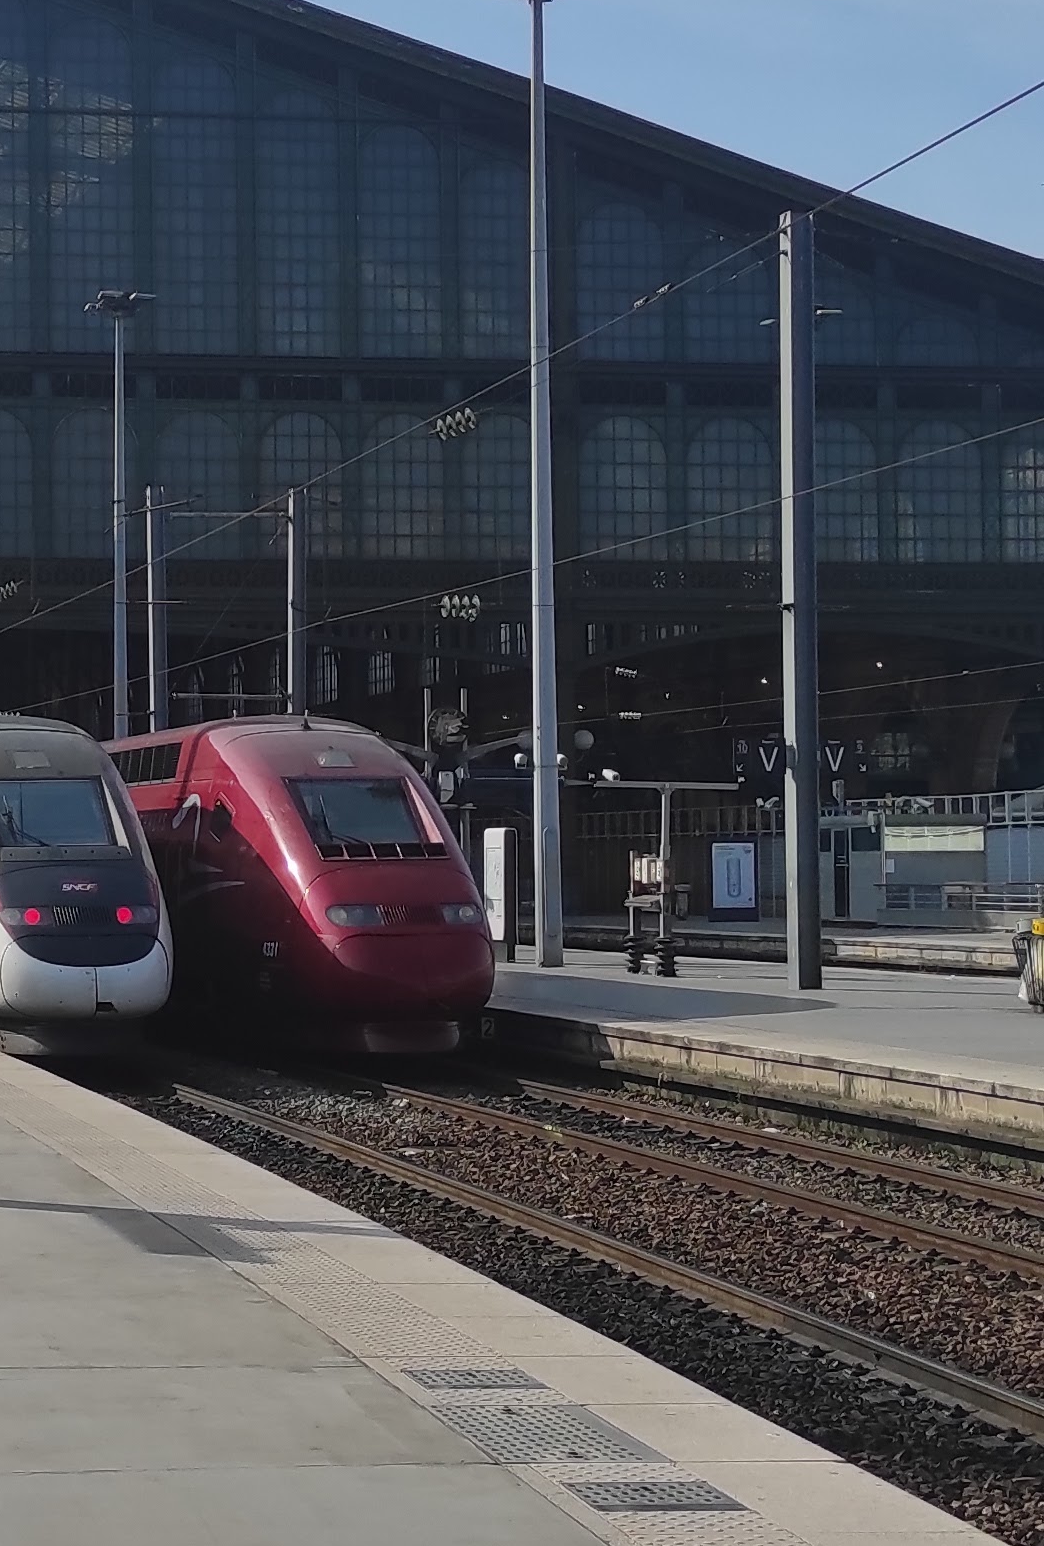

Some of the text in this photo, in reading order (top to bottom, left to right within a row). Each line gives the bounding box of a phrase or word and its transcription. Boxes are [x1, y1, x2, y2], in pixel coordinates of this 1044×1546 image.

[758, 746, 779, 772] V
[824, 746, 845, 772] V
[61, 883, 97, 892] SNCF
[483, 1019, 493, 1036] 2
